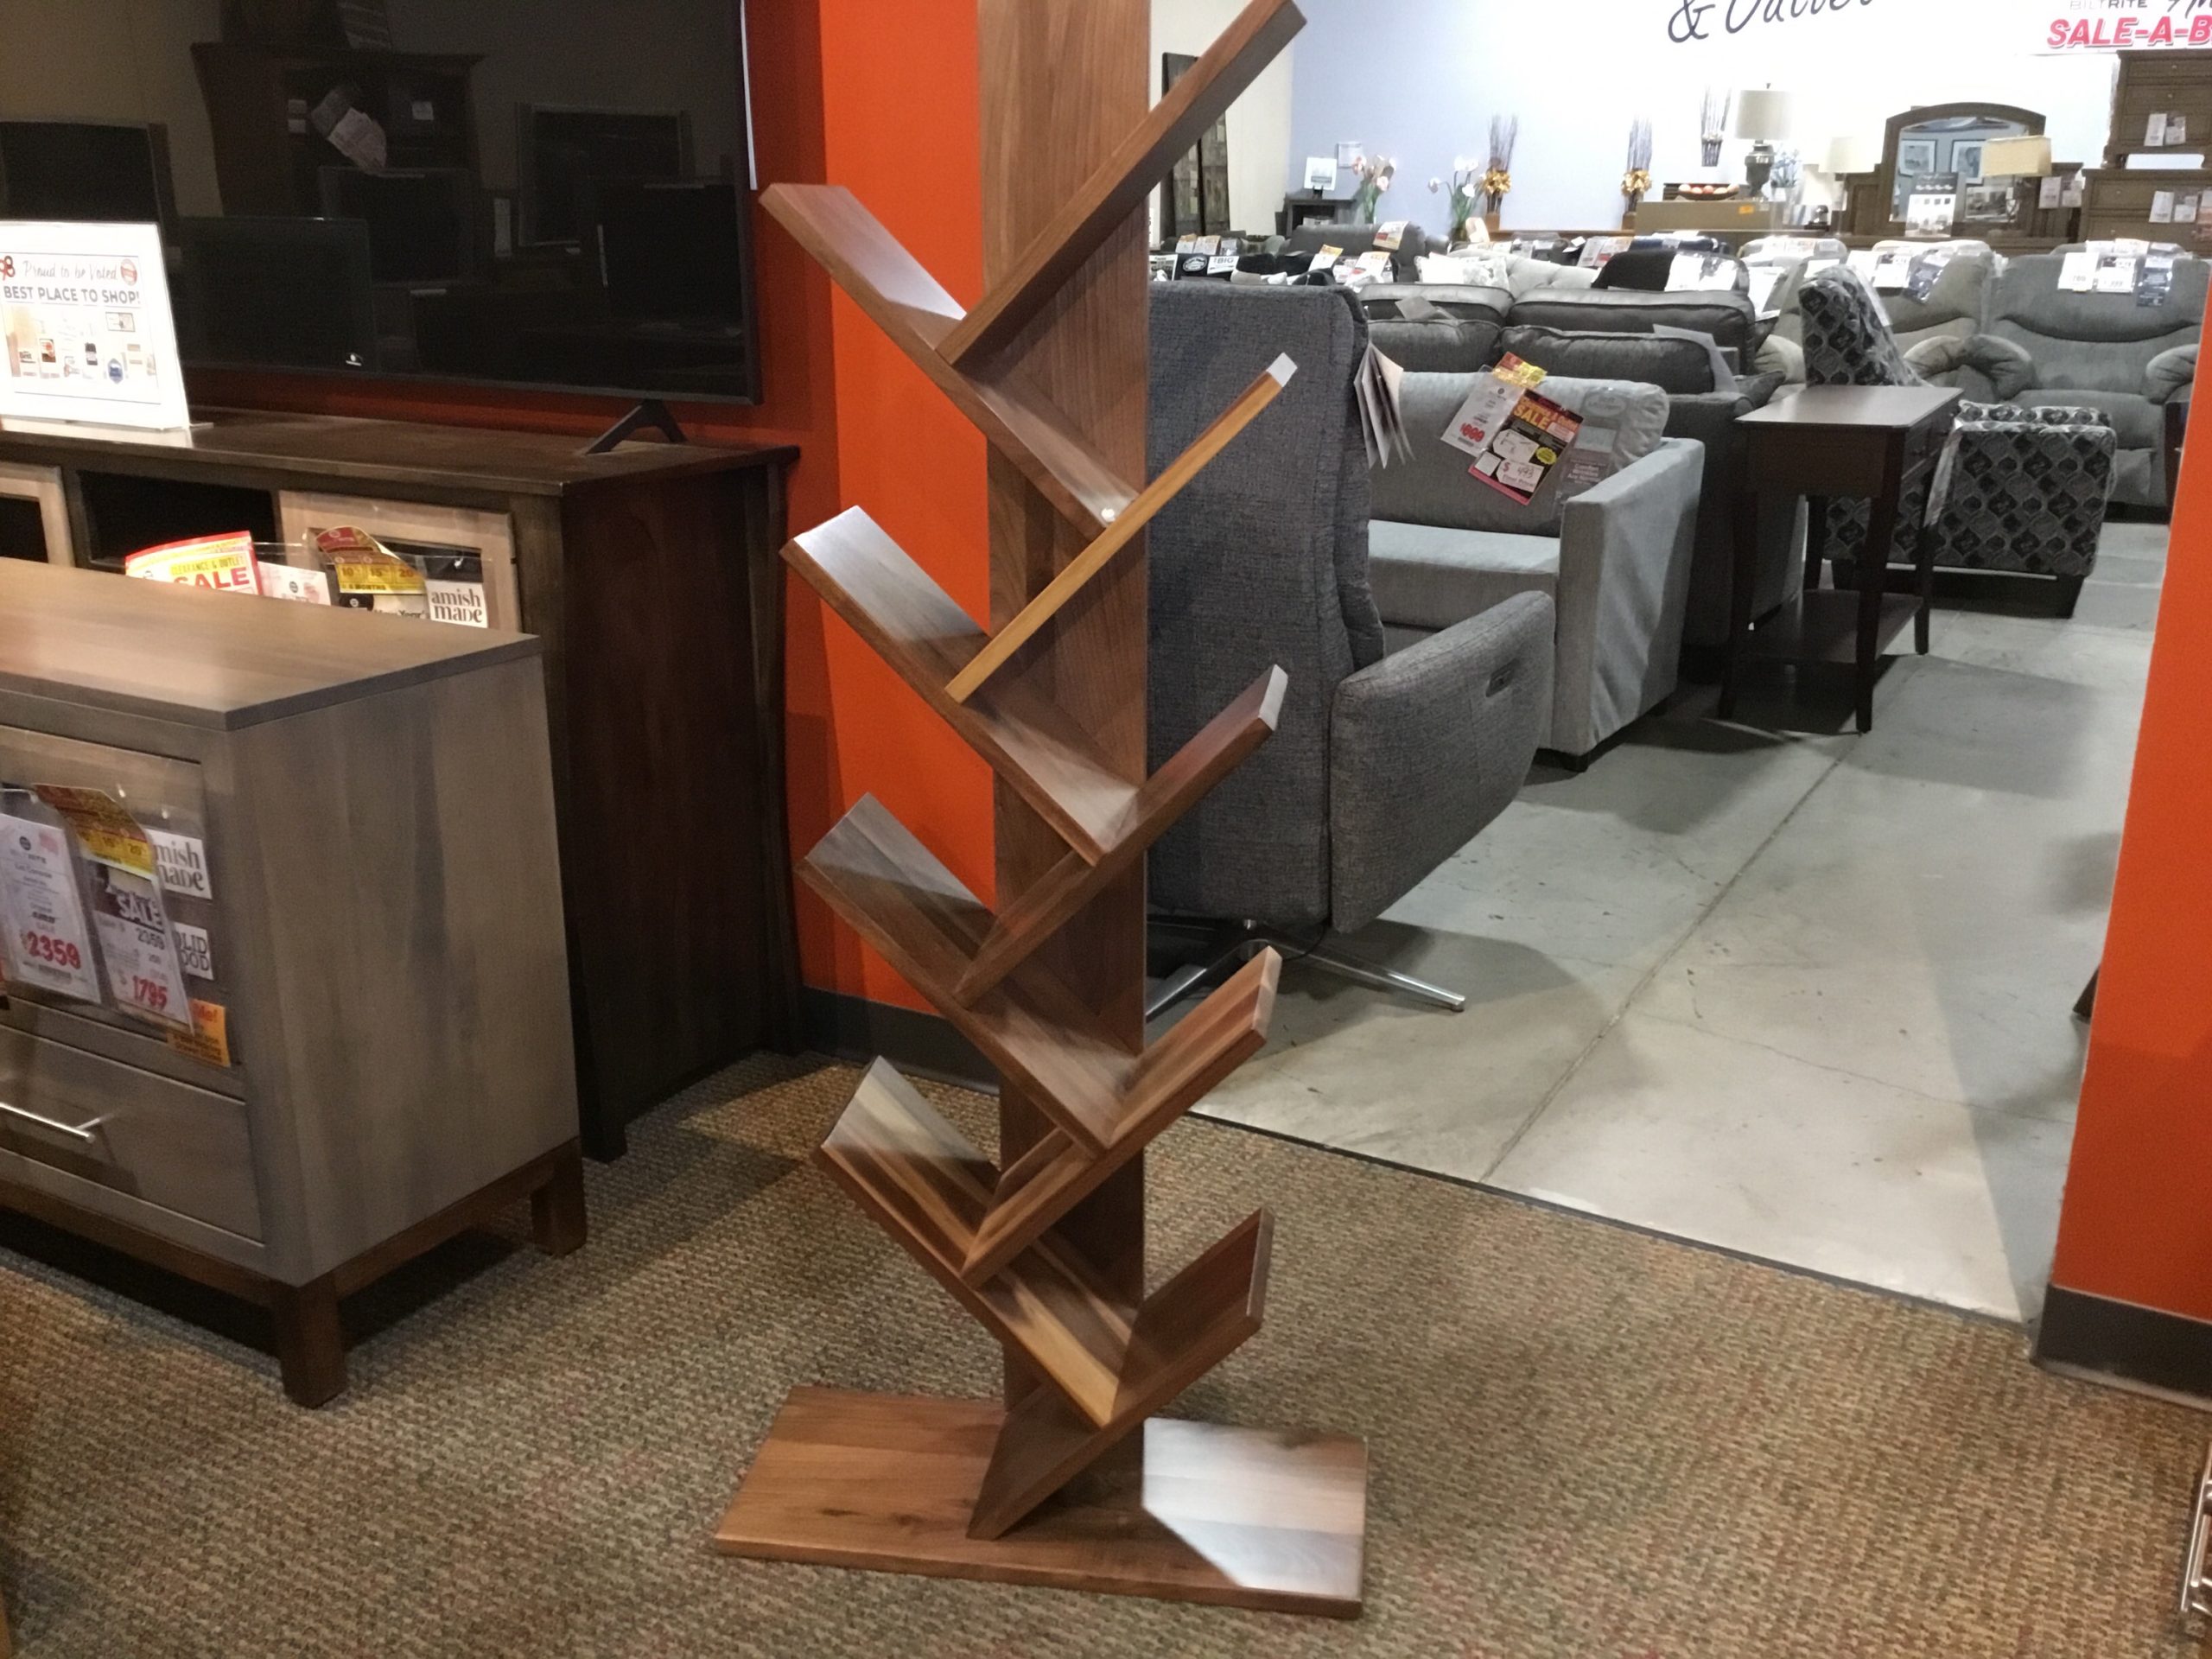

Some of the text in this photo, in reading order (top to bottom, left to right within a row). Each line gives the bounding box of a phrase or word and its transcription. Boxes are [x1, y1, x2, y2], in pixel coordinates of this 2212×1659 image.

[22, 260, 118, 281] Proud to be Voted
[3, 285, 141, 304] BEST PLACE TO SHOP!
[1514, 404, 1551, 430] SALE
[431, 588, 481, 608] amish
[154, 841, 201, 870] mish
[27, 931, 81, 969] 2359
[132, 975, 168, 1011] 1795
